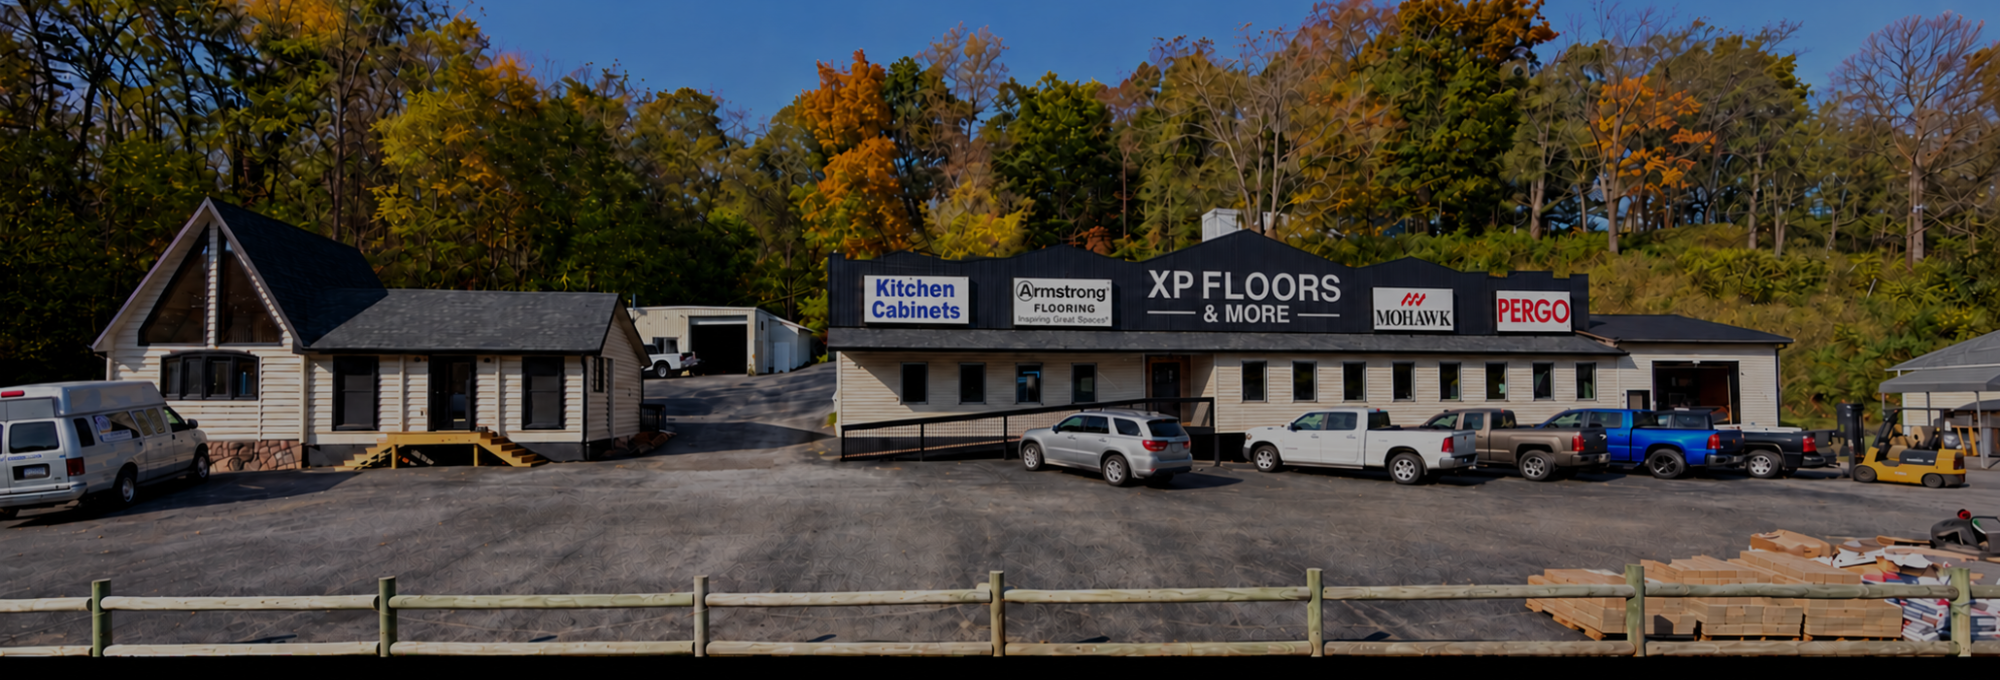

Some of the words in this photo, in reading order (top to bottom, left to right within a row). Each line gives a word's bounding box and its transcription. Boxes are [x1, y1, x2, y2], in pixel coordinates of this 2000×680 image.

[876, 278, 955, 298] Kitchen
[1016, 280, 1106, 303] Armstrong
[1149, 270, 1194, 299] XP
[1203, 271, 1341, 303] FLOORS
[871, 300, 961, 320] Cabinets
[1034, 303, 1096, 313] FLOORING
[1203, 305, 1218, 323] &
[1225, 305, 1290, 323] MORE
[1376, 309, 1451, 327] MOHAWK
[1498, 298, 1570, 323] PERGO
[1018, 315, 1051, 325] Inspiring
[1053, 315, 1075, 324] Great
